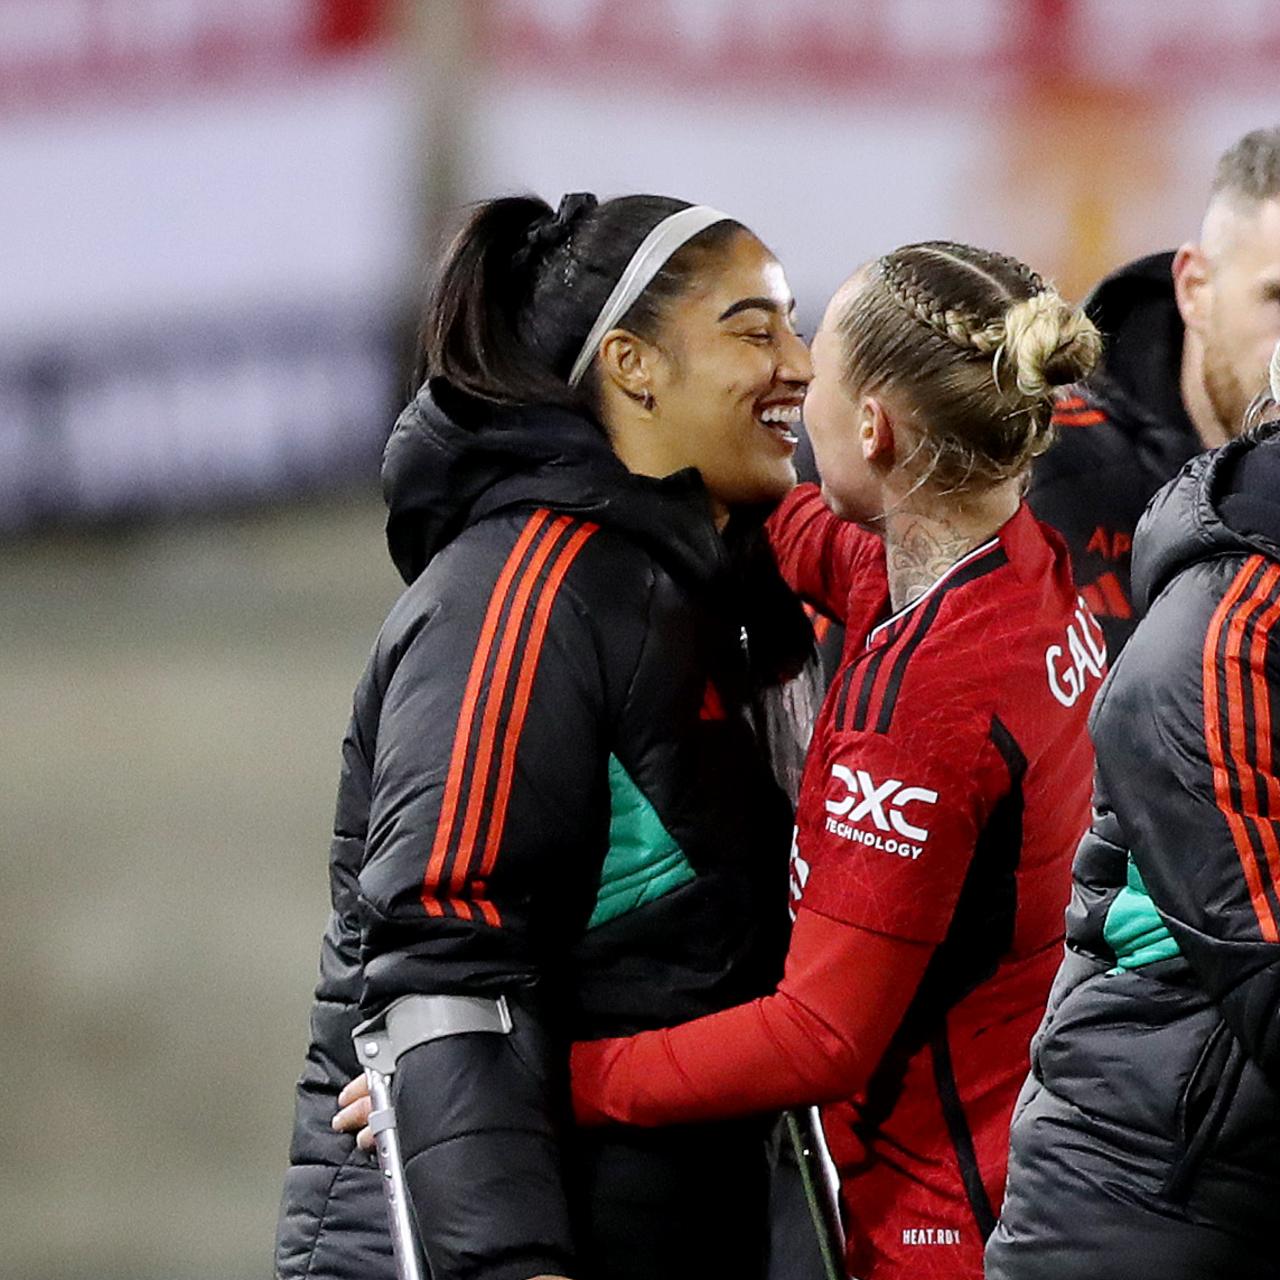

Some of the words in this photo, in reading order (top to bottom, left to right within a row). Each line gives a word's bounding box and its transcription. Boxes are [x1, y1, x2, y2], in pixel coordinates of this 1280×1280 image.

[1046, 596, 1107, 707] GAL
[825, 763, 939, 842] DXC
[825, 816, 923, 860] TECHNOLOGY
